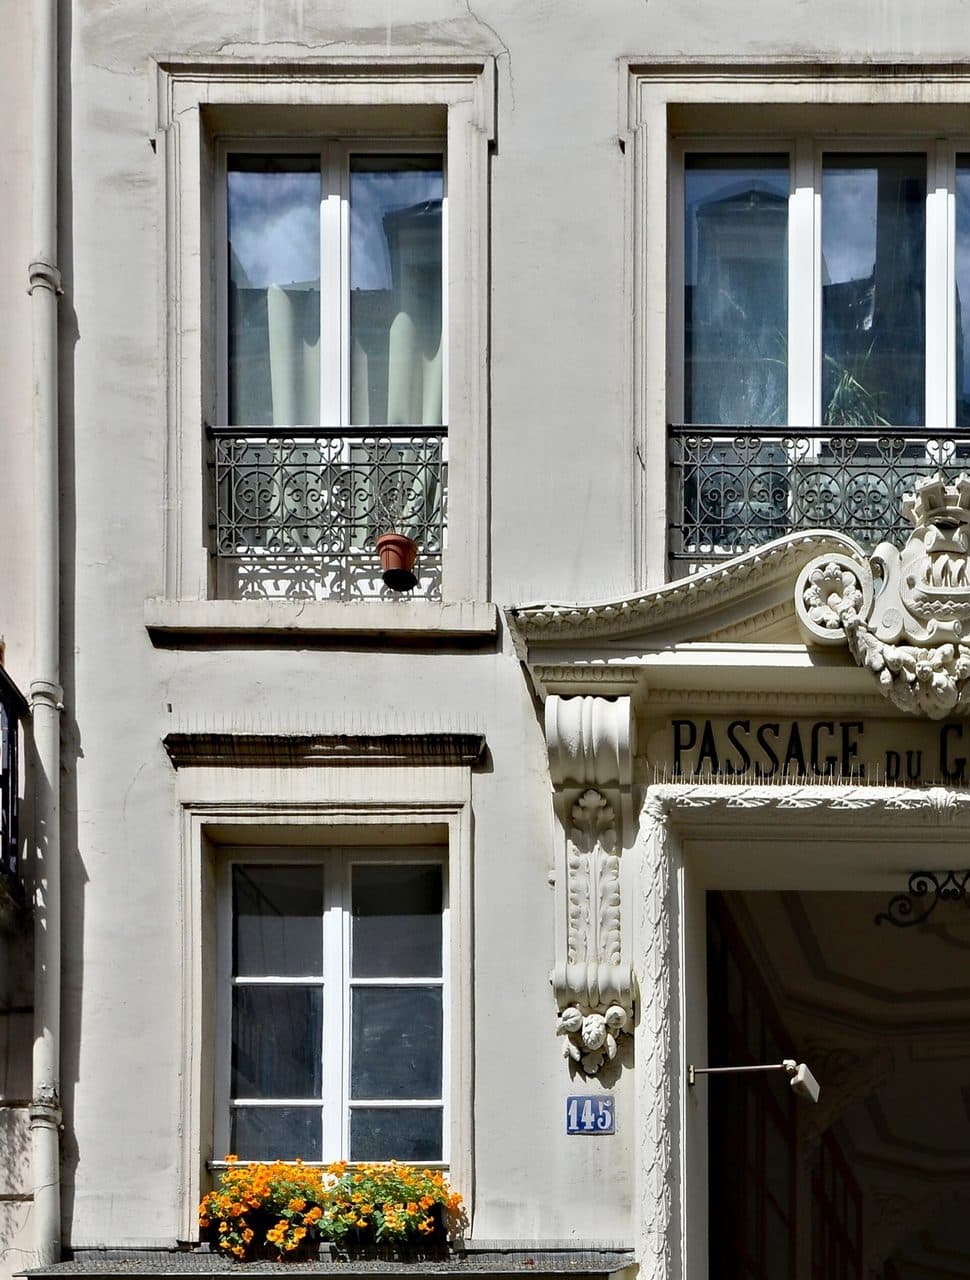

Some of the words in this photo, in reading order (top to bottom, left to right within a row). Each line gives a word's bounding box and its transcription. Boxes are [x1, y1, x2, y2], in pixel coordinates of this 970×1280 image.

[671, 719, 866, 780] PASSAGE
[885, 749, 922, 780] DU
[568, 1099, 612, 1130] 145
